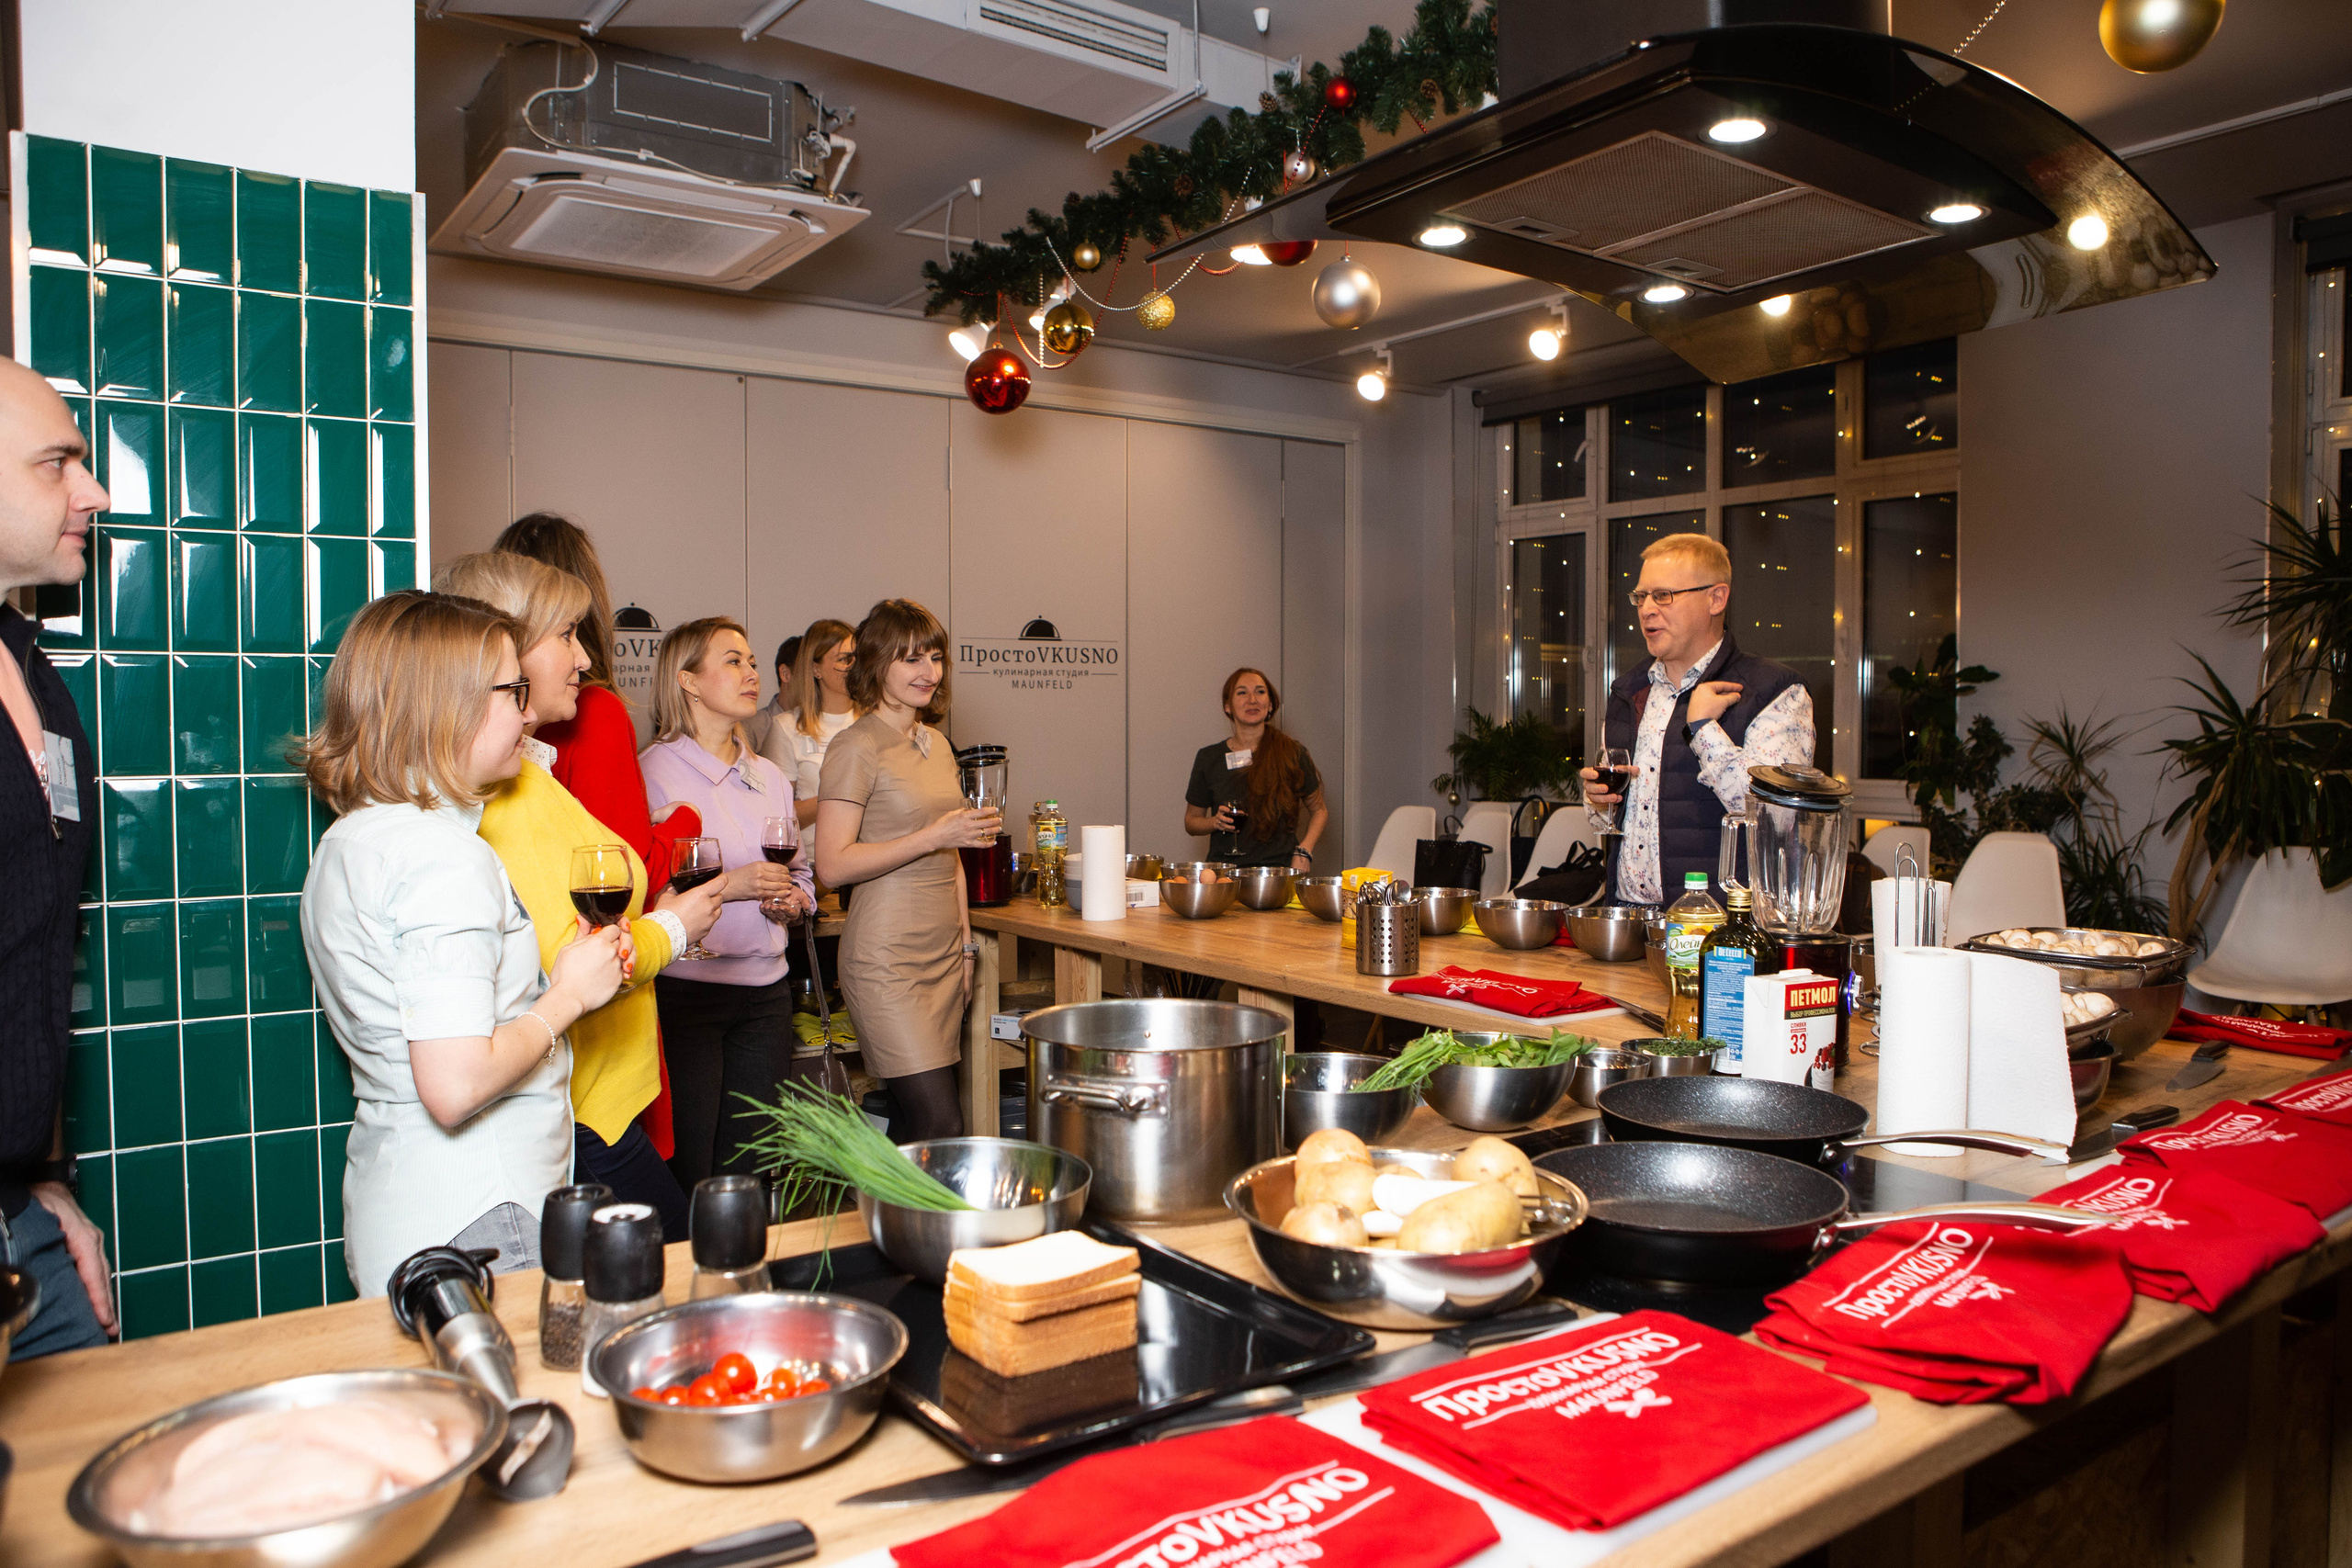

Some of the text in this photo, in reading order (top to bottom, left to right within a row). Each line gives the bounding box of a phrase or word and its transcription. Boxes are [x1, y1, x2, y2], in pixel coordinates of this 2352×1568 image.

[959, 645, 1118, 667] ПростоVKUSNO
[993, 668, 1090, 679] кулинарная студия
[1012, 680, 1073, 689] MAUNFELD
[1668, 938, 1702, 950] Олейн
[1790, 986, 1837, 1008] ПЕТМОЛ
[1790, 1033, 1807, 1055] 33
[1420, 1331, 1680, 1422] ПростоVKUSNO
[1114, 1467, 1369, 1568] тоVKUSNO
